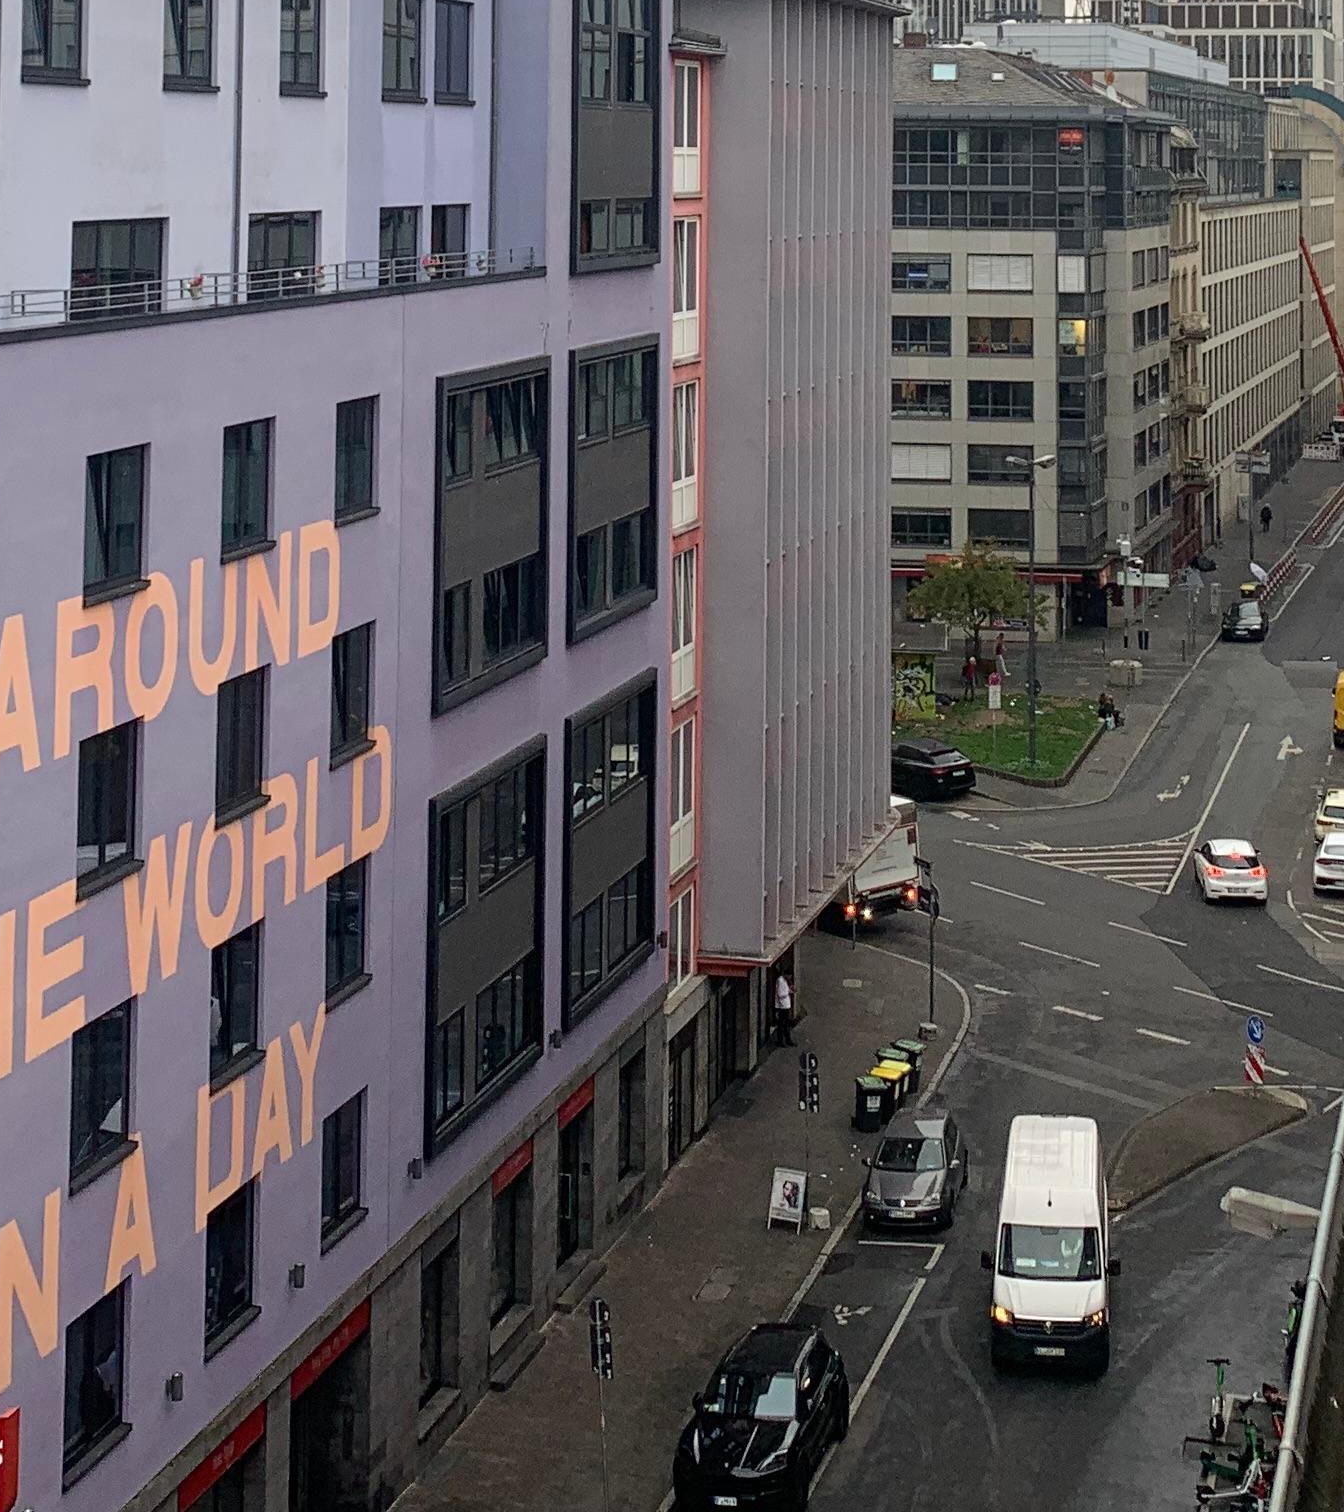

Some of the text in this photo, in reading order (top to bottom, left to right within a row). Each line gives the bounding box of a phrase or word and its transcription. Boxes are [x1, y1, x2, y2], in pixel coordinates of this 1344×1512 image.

[124, 725, 393, 995] WORLD
[104, 1131, 157, 1293] A
[195, 1002, 326, 1234] DAY
